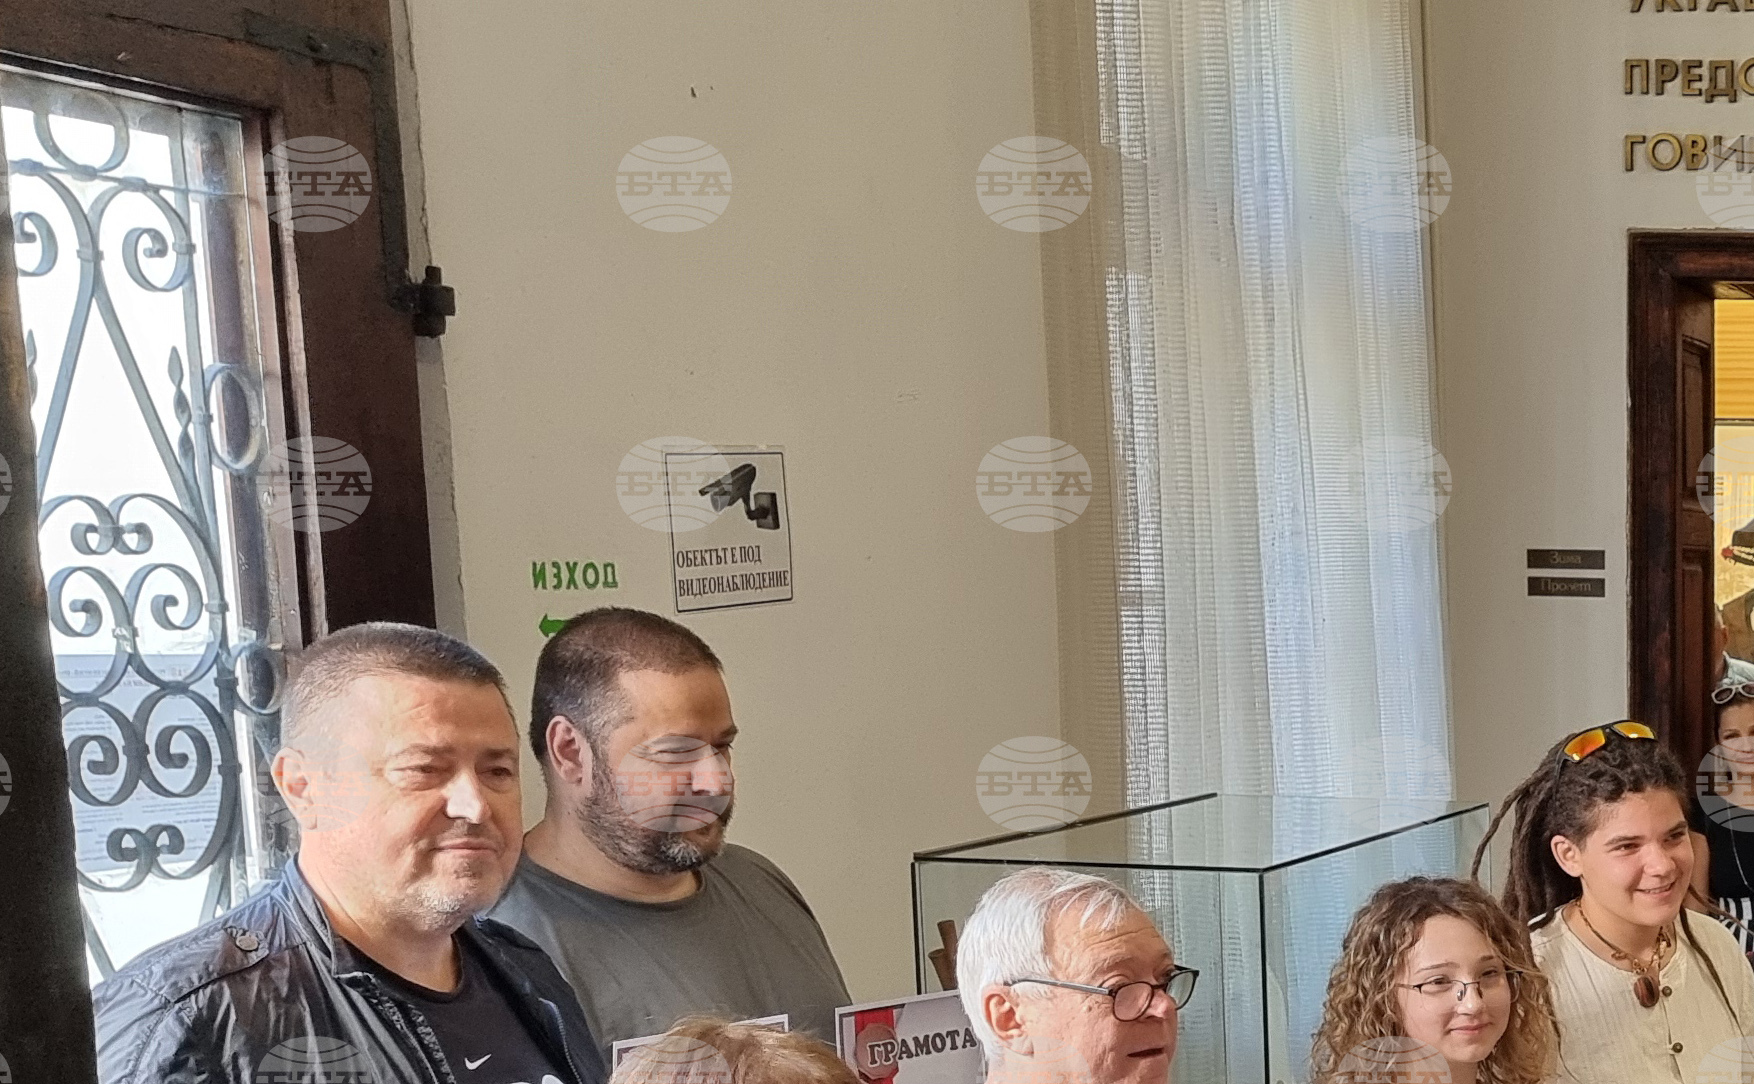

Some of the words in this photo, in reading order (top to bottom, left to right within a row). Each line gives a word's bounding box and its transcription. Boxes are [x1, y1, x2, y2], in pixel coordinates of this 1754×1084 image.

[676, 547, 729, 569] ОБЕКТЪТ
[730, 546, 738, 565] Е
[739, 545, 762, 566] ПОД
[531, 560, 619, 590] ИЗХОД
[678, 569, 790, 599] ВИДЕОНАБЛЮДЕНИЕ
[867, 1027, 978, 1066] ГРАМОТА
